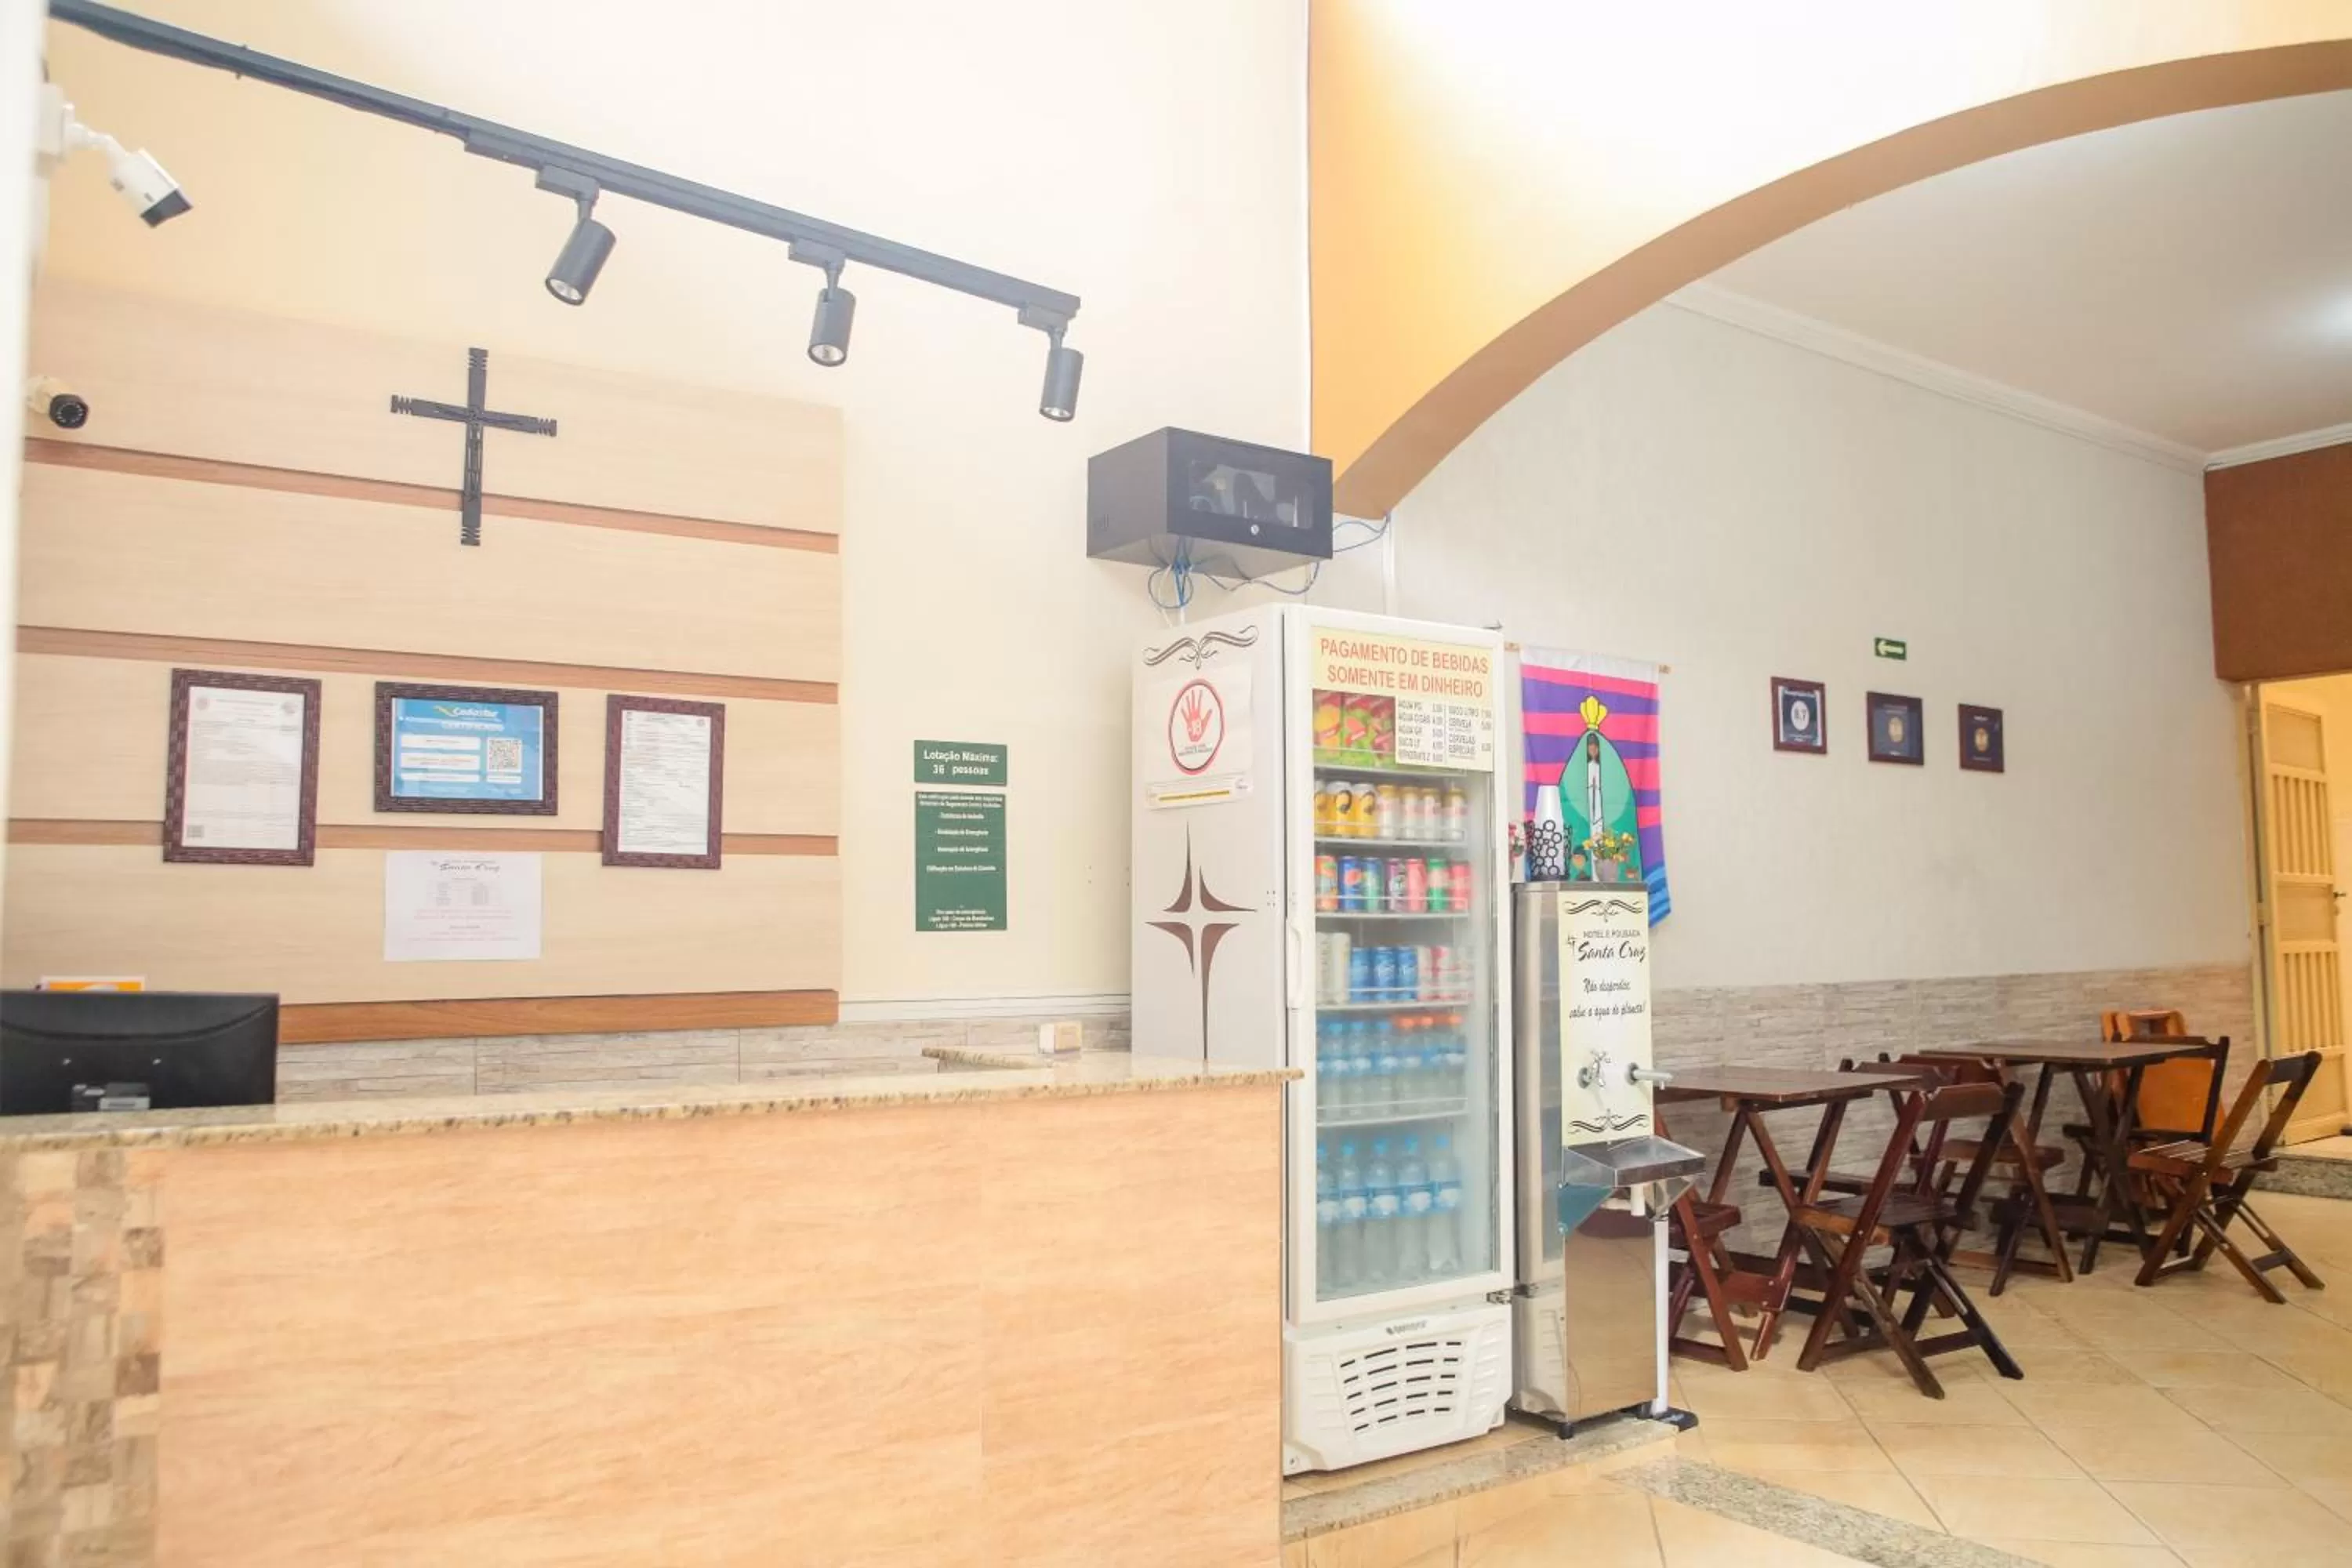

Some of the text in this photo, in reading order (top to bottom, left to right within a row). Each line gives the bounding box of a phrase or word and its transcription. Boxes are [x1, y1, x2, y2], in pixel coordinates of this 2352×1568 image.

[1320, 637, 1488, 674] PAGAMENTO DE BEBIDAS
[1327, 665, 1483, 698] SOMENTE EM DINHEIRO
[924, 750, 960, 762] Lotação
[933, 764, 989, 776] 36 pessoas
[1578, 941, 1646, 962] Santa Cruz
